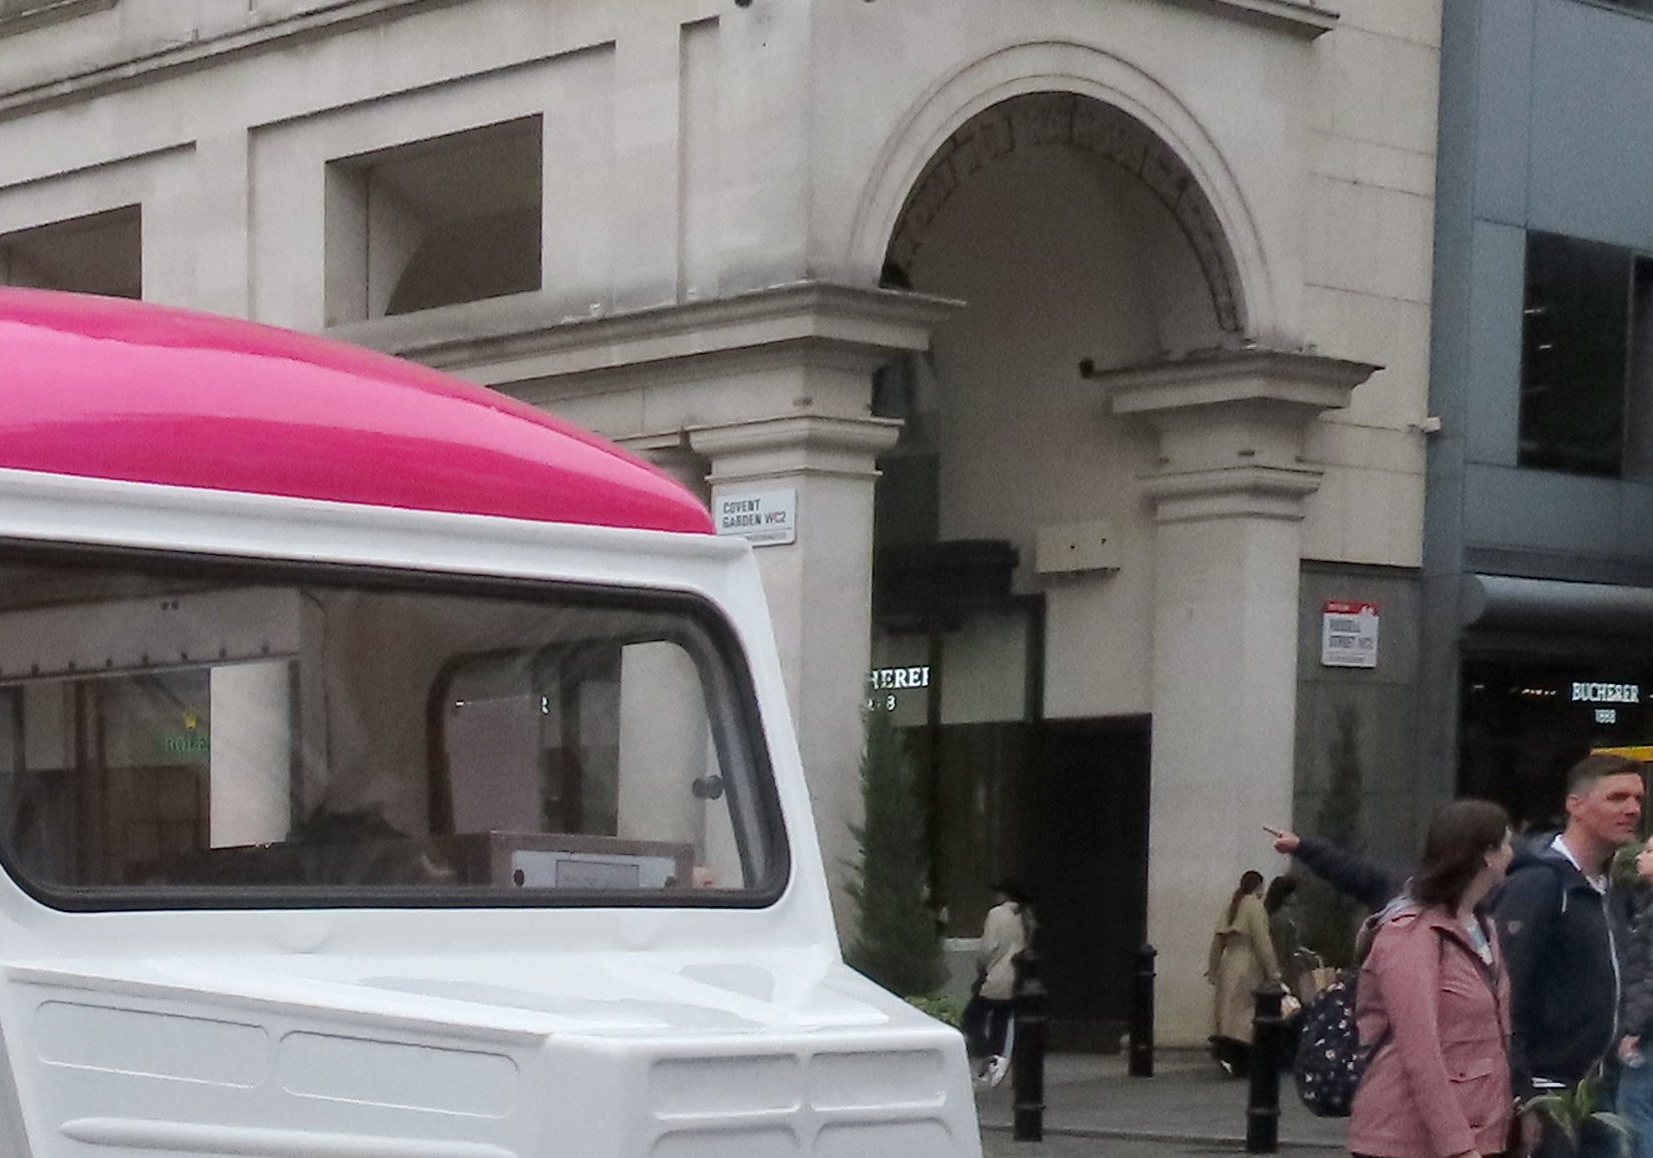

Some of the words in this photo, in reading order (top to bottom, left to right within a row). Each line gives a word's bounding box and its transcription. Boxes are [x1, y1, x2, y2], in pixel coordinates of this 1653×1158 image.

[723, 499, 761, 514] COVENT
[723, 514, 761, 528] GARDEN
[765, 511, 787, 524] WC2
[1572, 682, 1640, 703] BUCHERER
